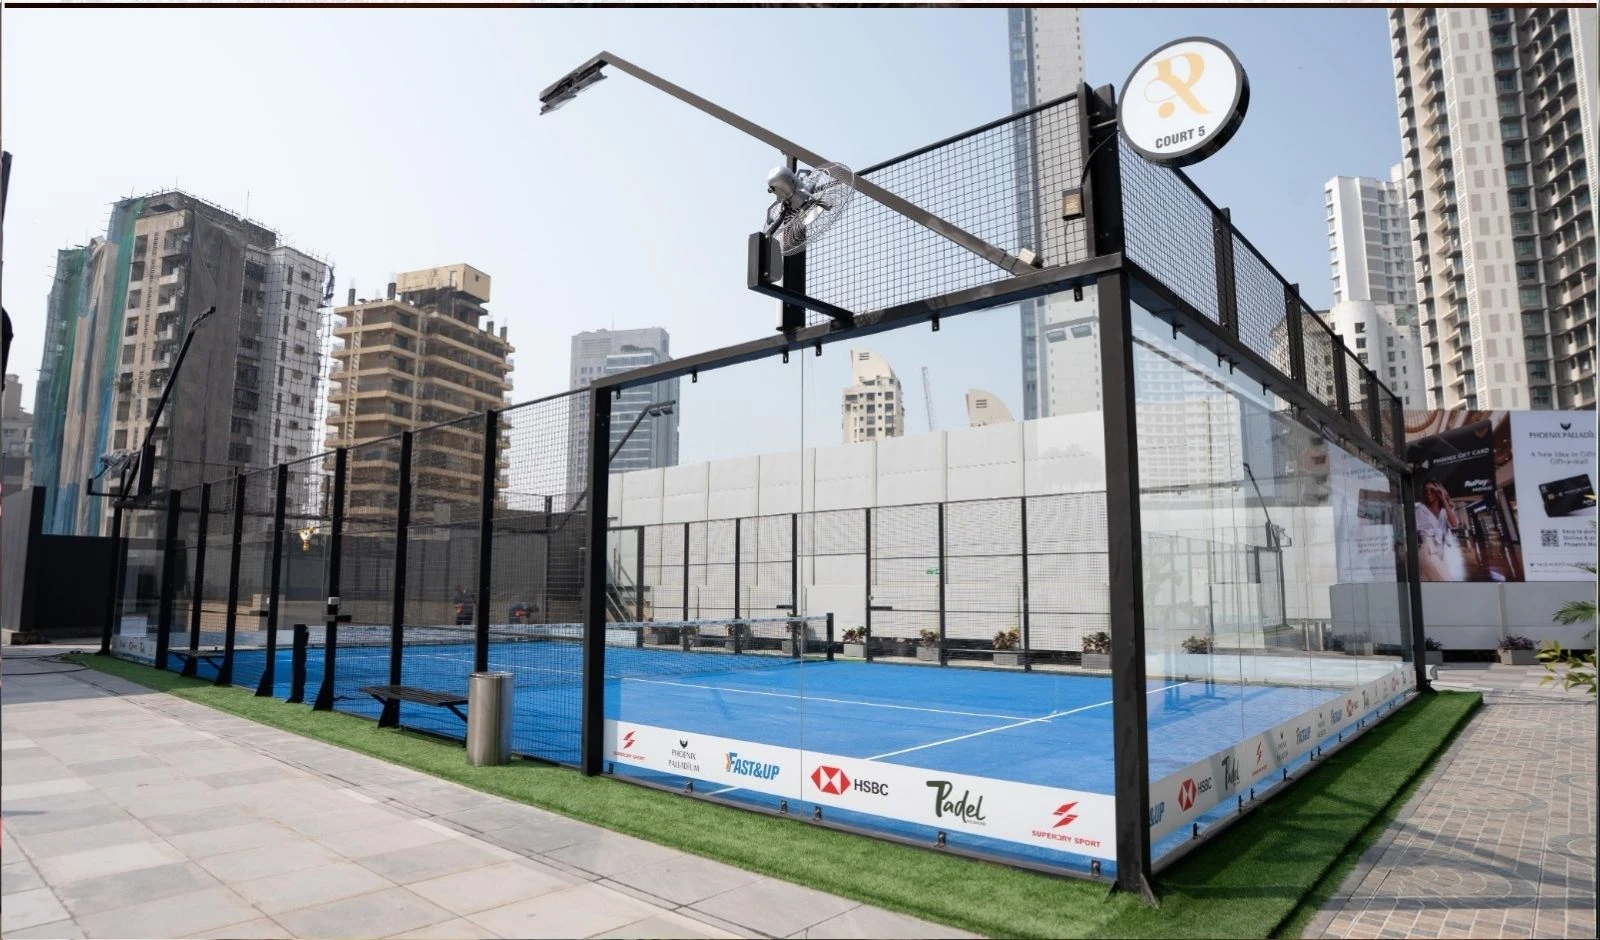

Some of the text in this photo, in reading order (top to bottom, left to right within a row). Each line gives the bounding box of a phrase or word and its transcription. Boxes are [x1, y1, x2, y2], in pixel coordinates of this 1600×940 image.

[1155, 126, 1206, 149] COURT 5
[1529, 431, 1561, 439] PHOENIX
[1472, 447, 1490, 456] CARD
[671, 748, 697, 761] PHOENIX
[725, 751, 780, 781] FAST&UP
[854, 778, 889, 796] HSBC
[1198, 777, 1212, 795] HSBC
[926, 780, 986, 824] Padel
[1074, 836, 1102, 848] SPORT
